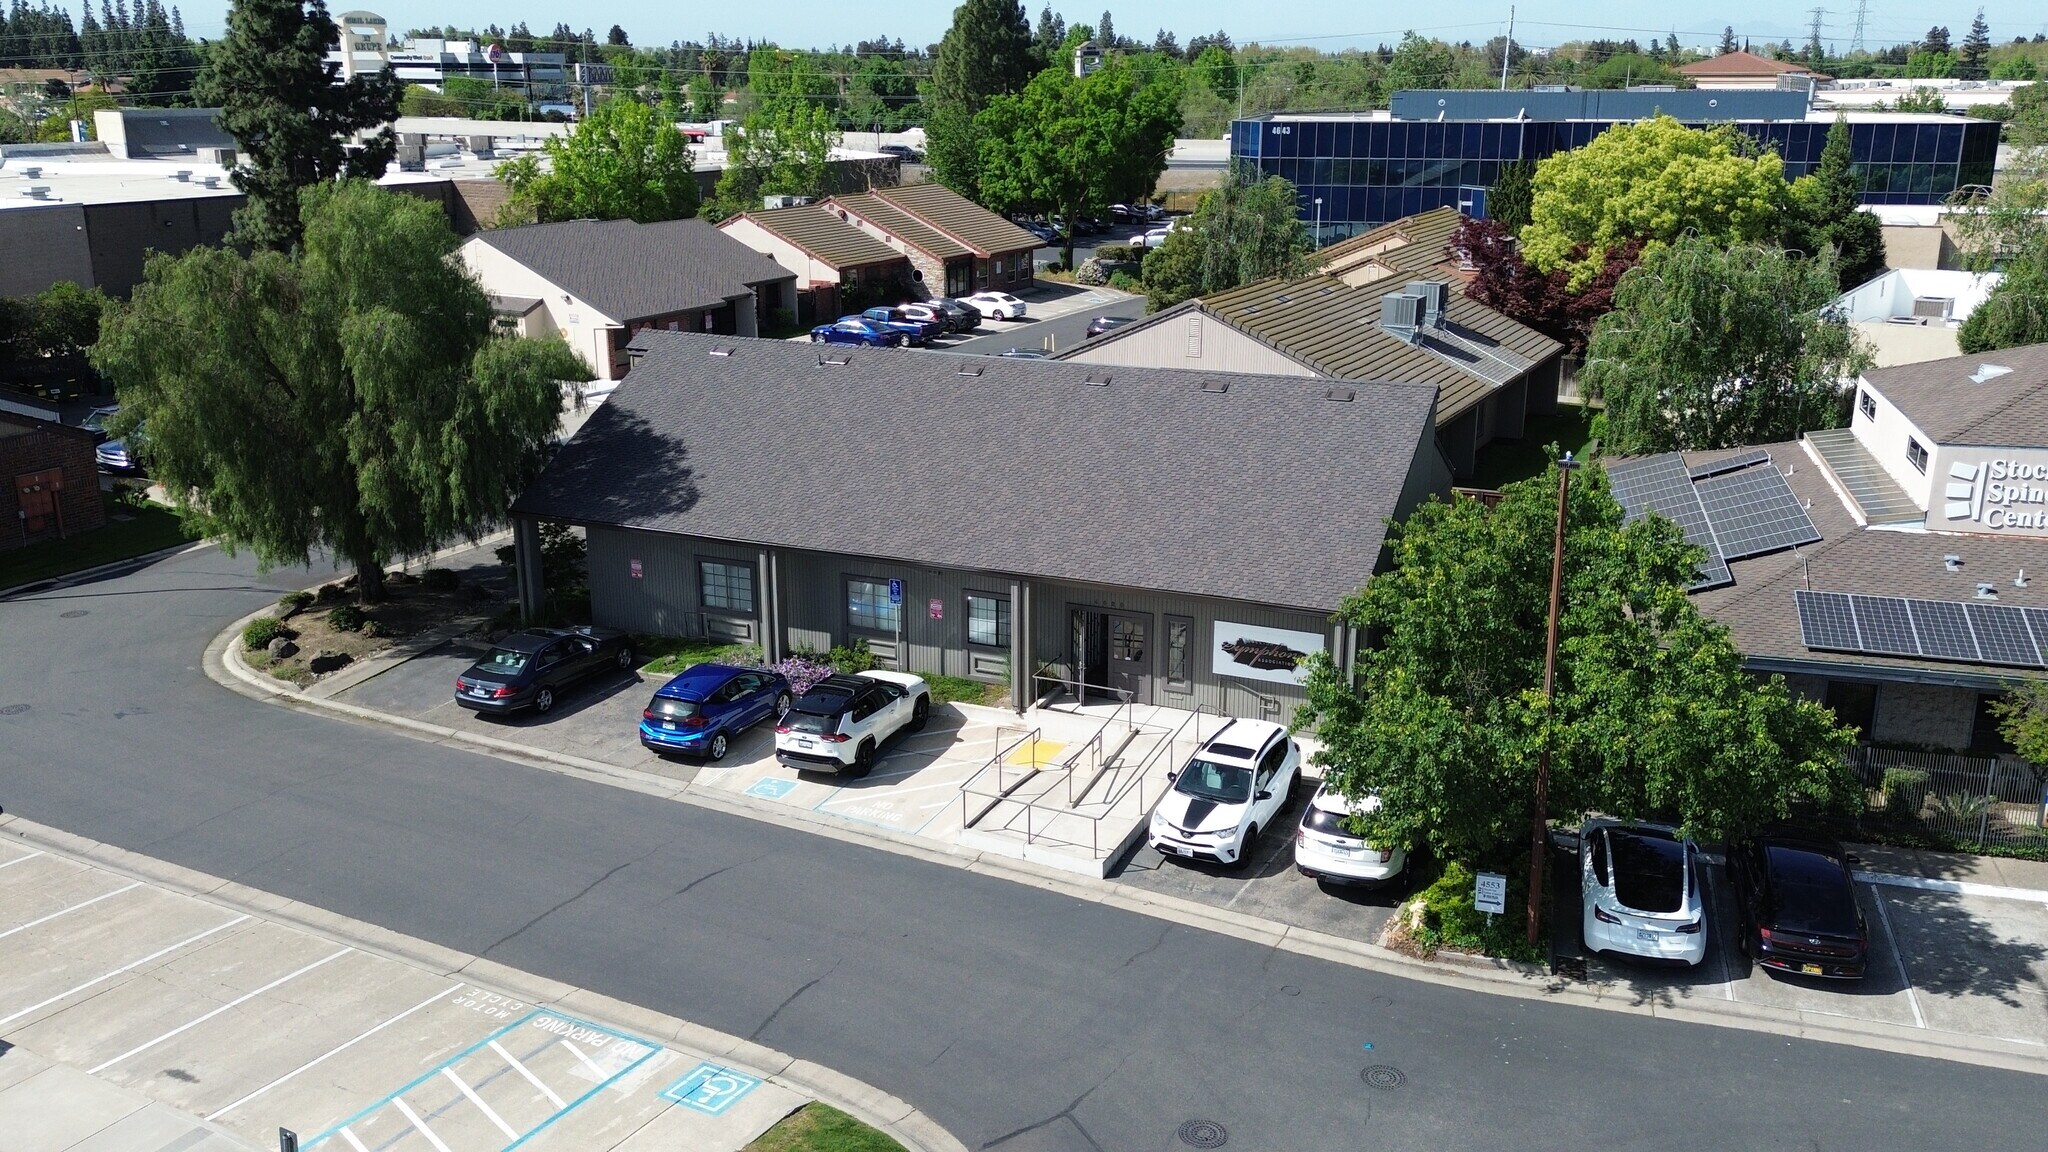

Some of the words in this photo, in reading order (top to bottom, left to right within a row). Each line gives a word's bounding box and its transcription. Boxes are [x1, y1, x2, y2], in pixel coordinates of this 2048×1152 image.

[1271, 126, 1291, 135] 4643
[1990, 459, 2048, 480] Stoc
[1221, 642, 1306, 672] Symphon
[844, 805, 903, 821] PARKING
[872, 801, 894, 810] NO
[1480, 880, 1501, 890] 4553
[452, 996, 511, 1019] MOTOR
[466, 989, 523, 1010] CYCLE
[532, 1016, 613, 1048] PARKING
[611, 1041, 645, 1057] NO
